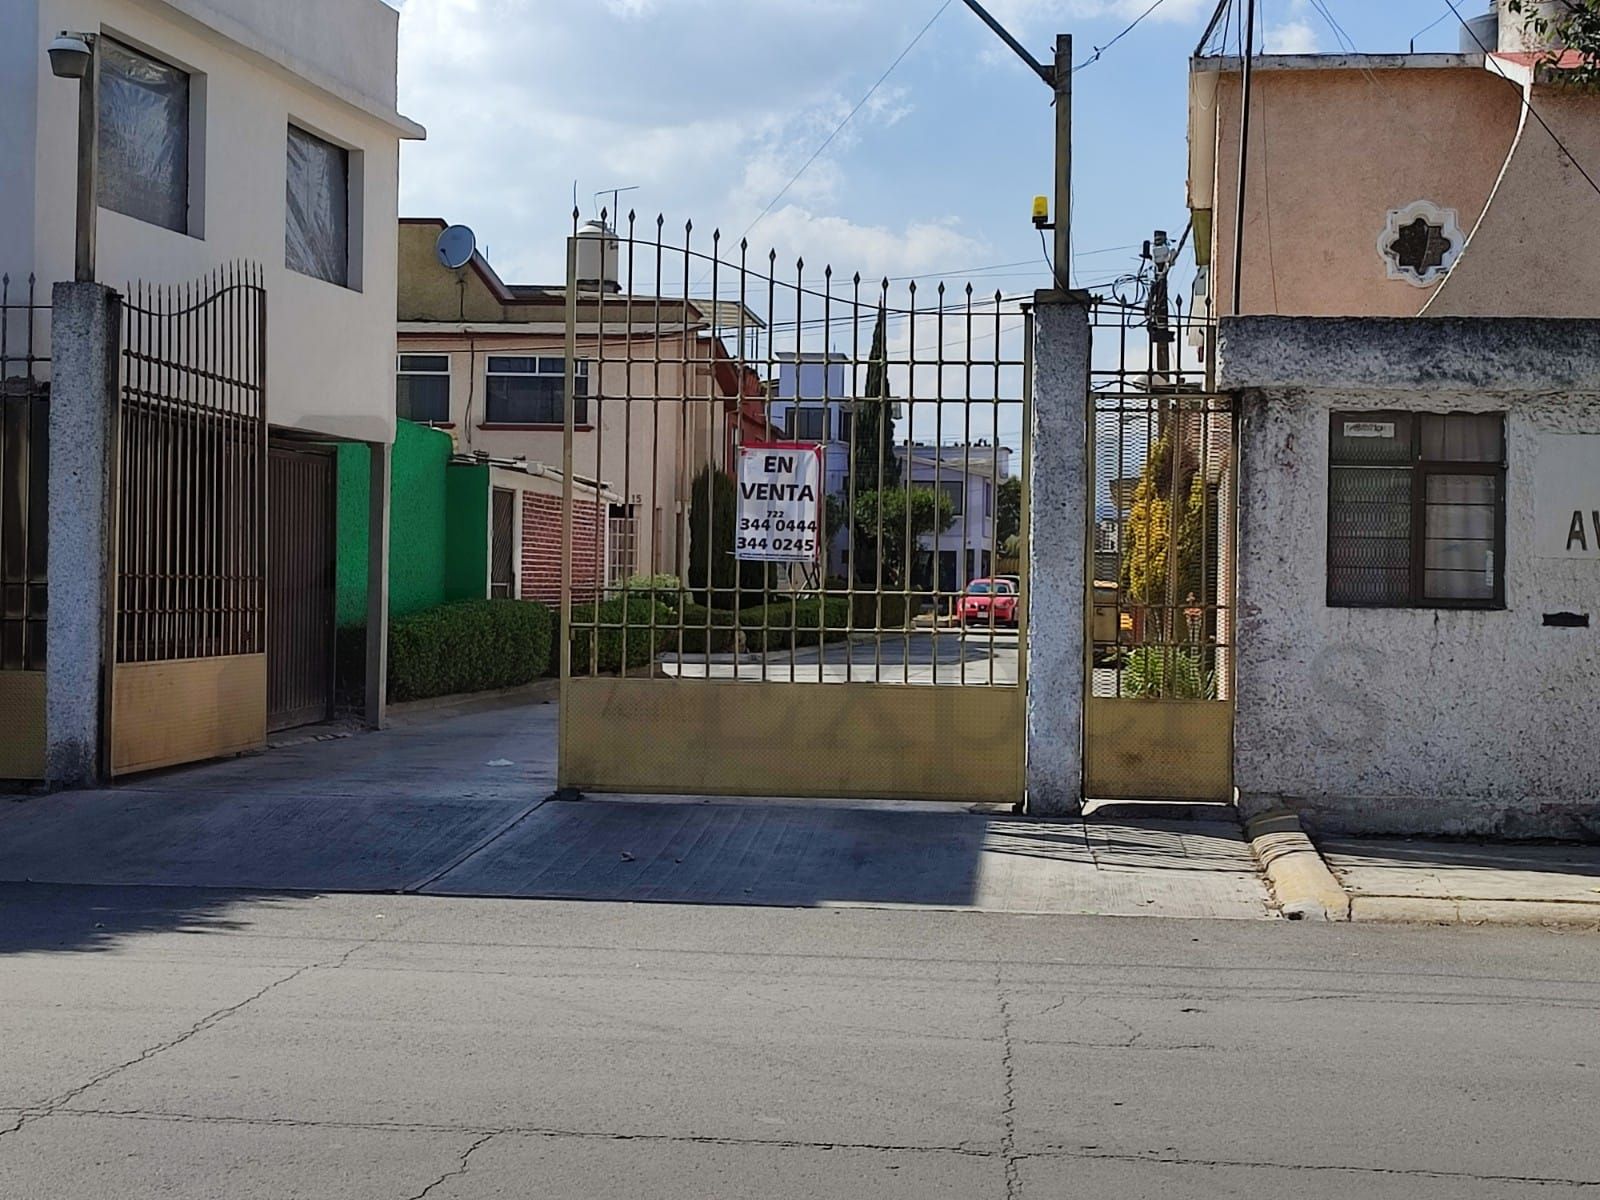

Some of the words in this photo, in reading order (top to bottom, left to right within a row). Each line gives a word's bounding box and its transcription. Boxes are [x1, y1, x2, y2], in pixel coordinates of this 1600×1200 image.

[764, 456, 793, 473] EN
[632, 494, 642, 503] 15
[741, 483, 814, 501] VENTA
[740, 519, 770, 531] 344
[775, 520, 817, 532] 0444
[737, 537, 768, 550] 344
[772, 538, 814, 552] 0245
